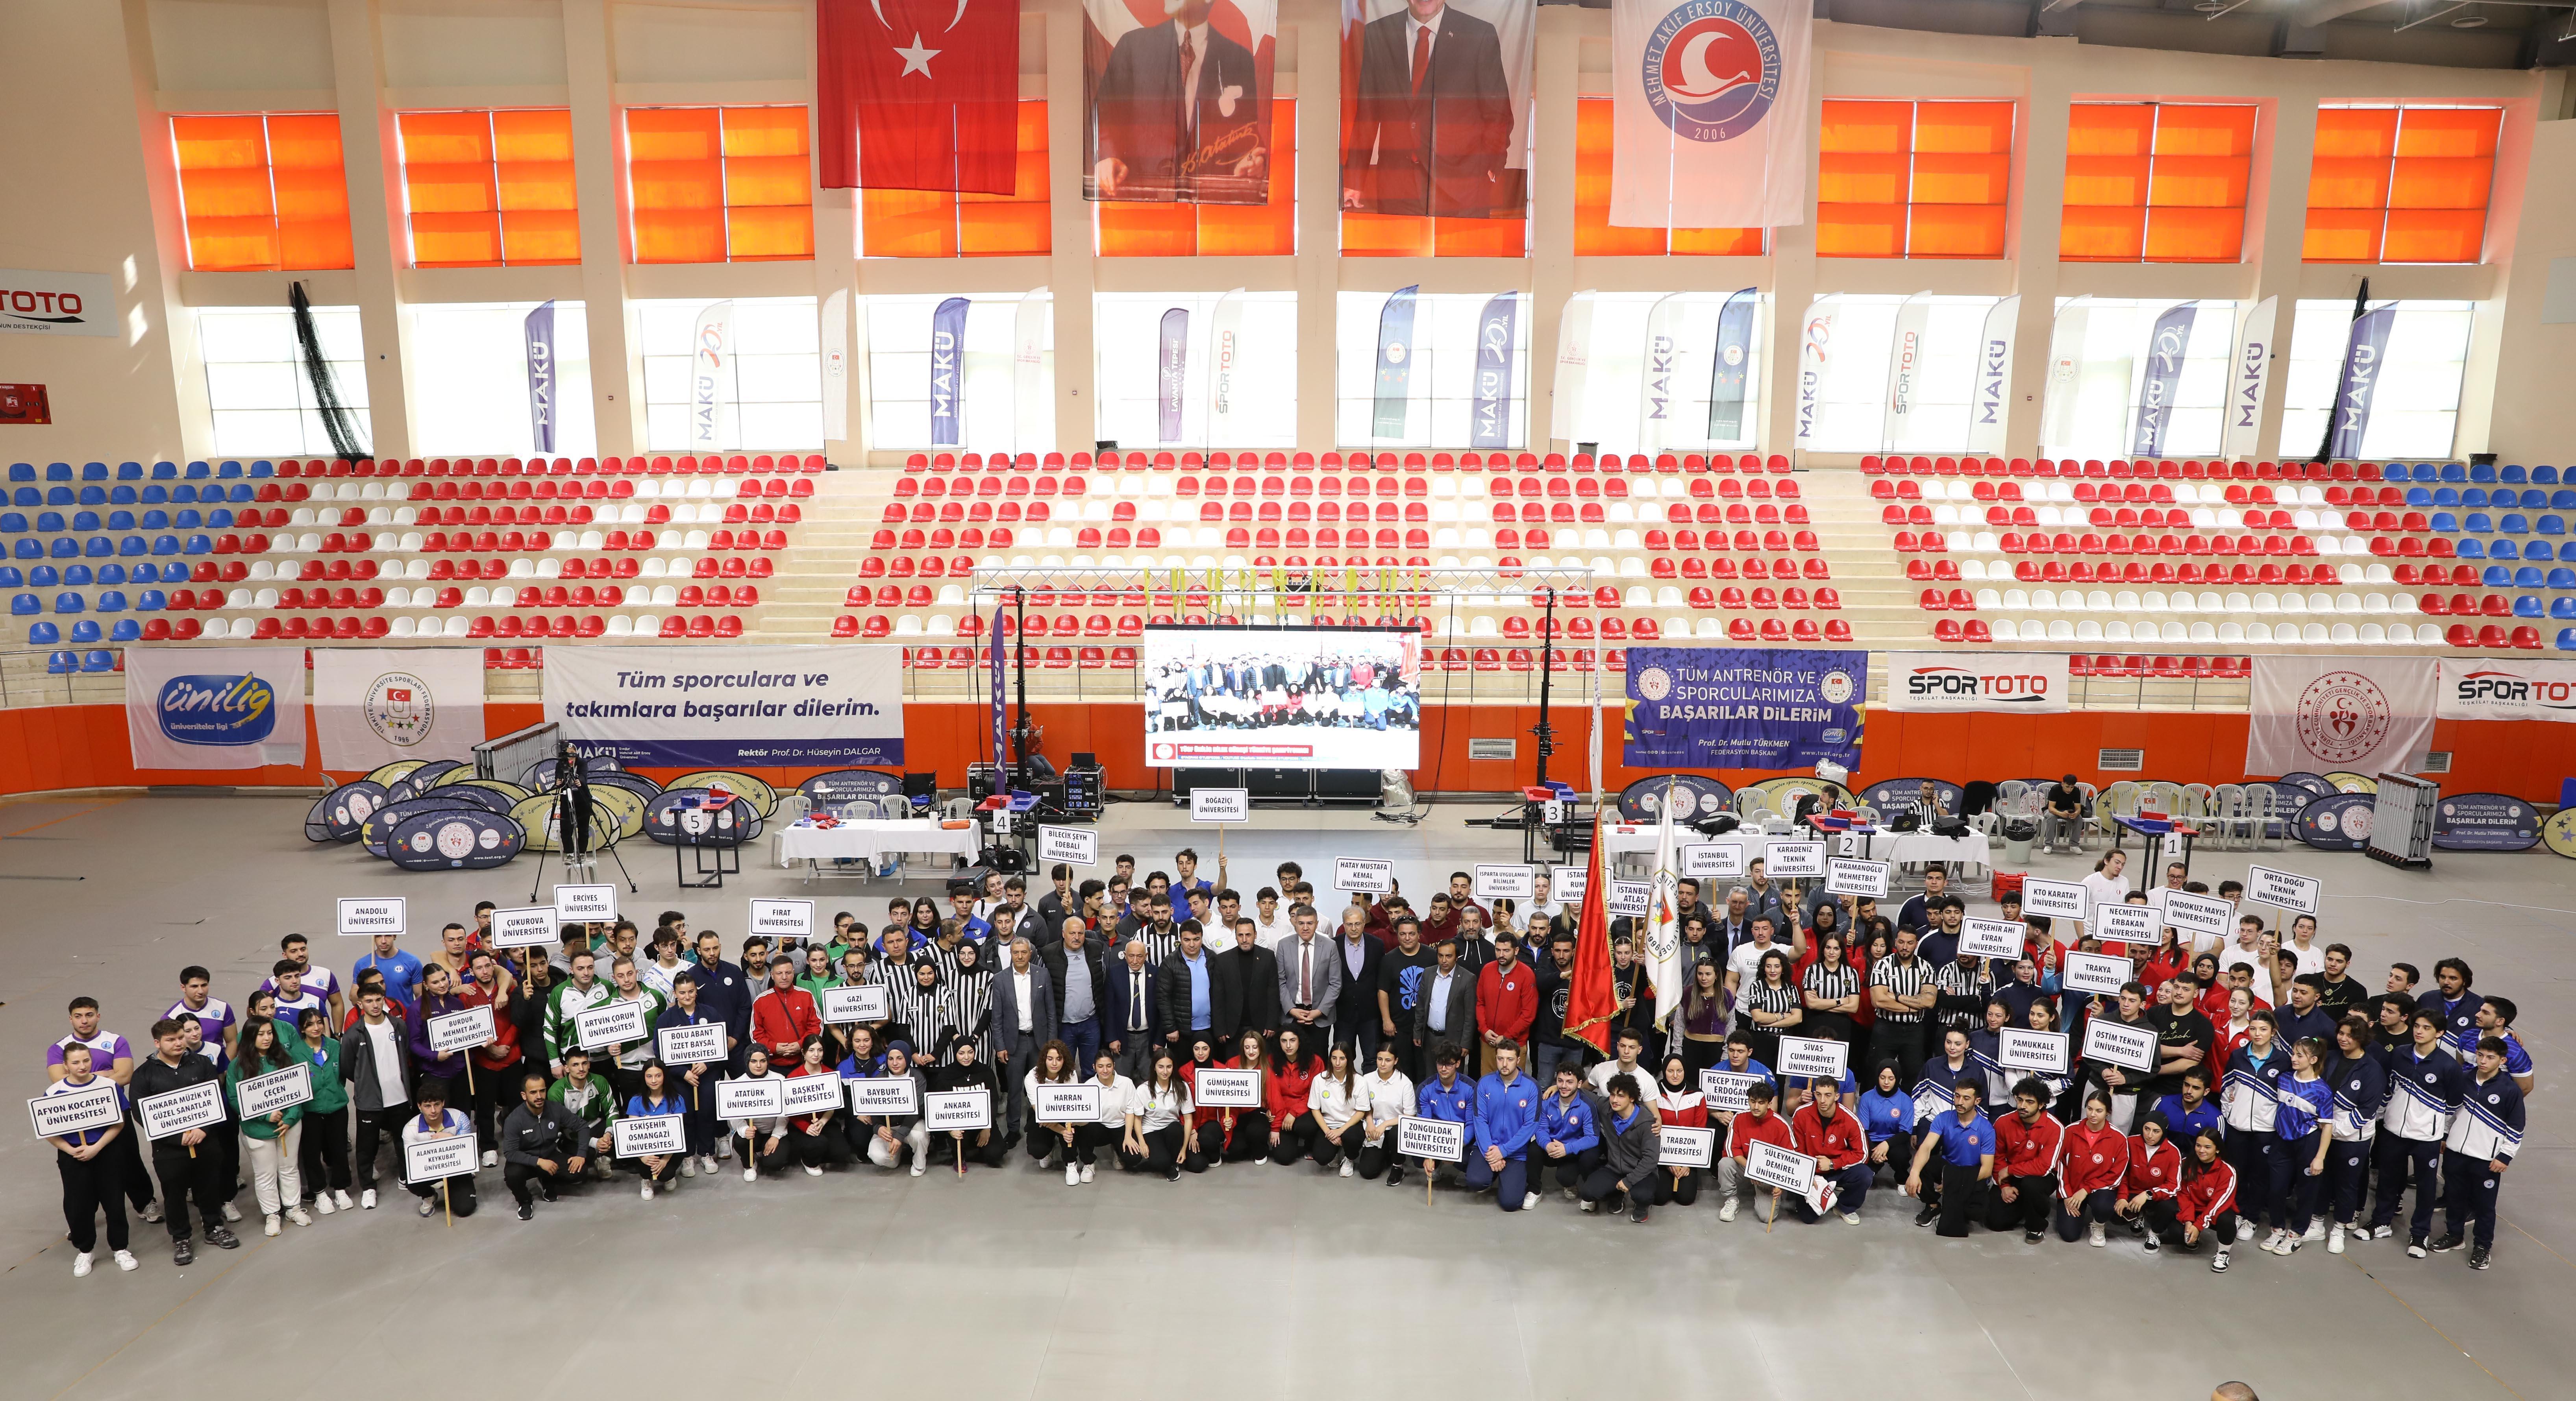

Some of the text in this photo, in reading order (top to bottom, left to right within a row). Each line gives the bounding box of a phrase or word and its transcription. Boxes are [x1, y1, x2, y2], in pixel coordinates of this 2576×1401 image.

[1646, 1, 1781, 106] MEHMET AKİF ERSOY ÜNİVERSİTESİ
[1694, 128, 1726, 140] 2006
[933, 331, 954, 416] MAKÜ
[1649, 336, 1673, 419] MAKÜ
[533, 342, 549, 425] MAKÜ
[1979, 340, 2006, 423] MAKÜ
[2237, 342, 2263, 427] MAKÜ
[2341, 345, 2375, 430] MAKÜ
[617, 670, 829, 692] Tüm sporculara ve
[1676, 666, 1815, 684] TÜM ANTRENÖR VE
[1677, 686, 1816, 702] SPORCULARIMIZA
[566, 698, 879, 722] takımlara başarılar dilerim.
[1660, 705, 1759, 722] BAŞARILAR
[1753, 738, 1790, 747] TÜRKMEN
[807, 748, 841, 757] Hüseyin
[1549, 806, 1558, 820] 3
[691, 815, 700, 829] 5
[997, 816, 1007, 830] 4
[1049, 830, 1071, 839] BİLECİK
[1055, 841, 1079, 849] EDEBALİ
[1844, 838, 1853, 852] 2
[2169, 840, 2176, 854] 1
[1835, 862, 1882, 873] KARAMANOĞLU
[1838, 872, 1877, 882] MEHMETBEY
[2264, 873, 2304, 887] ORTA DOĞU
[1617, 885, 1648, 895] İSTANBU
[2048, 890, 2077, 899] KARATAY
[2270, 884, 2296, 896] TEKNİK
[2032, 898, 2077, 909] ÜNİVERSİTESİ
[2257, 890, 2306, 908] ÜNİVERSİTESİ
[2110, 908, 2149, 918] NECMETTİN
[2169, 900, 2226, 917] ONDOKUZ MAYIS
[507, 917, 544, 928] ÇUKUROVA
[1972, 923, 2002, 932] KIRŞEHİR
[2112, 918, 2144, 928] ERBAKAN
[503, 927, 549, 937] ÜNİVERSİTESİ
[1981, 934, 2002, 943] EVRAN
[2086, 964, 2111, 973] TRAKYA
[2074, 973, 2121, 985] ÜNİVERSİTESİ
[833, 1004, 877, 1013] ÜNİVERSİTESİ
[449, 1016, 473, 1027] BURDUR
[585, 1012, 635, 1028] ARTVİN ÇORUH
[443, 1023, 481, 1037] MEHMET AKİF
[671, 1029, 713, 1040] BOLU ABANT
[435, 1029, 492, 1049] ERSOY ÜNİVERSİTESİ
[690, 1039, 715, 1048] BAYSAL
[2013, 1039, 2054, 1050] PAMUKKALE
[2096, 1031, 2145, 1048] OSTİM TEKNİK
[1804, 1042, 1823, 1052] SİVAS
[2095, 1041, 2142, 1058] ÜNİVERSİTESİ
[1790, 1053, 1835, 1063] CUMHURİYET
[2010, 1050, 2056, 1061] ÜNİVERSİTESİ
[1788, 1063, 1835, 1074] ÜNİVERSİTESİ
[248, 1070, 298, 1092] AĞRI İBRAHİM
[1207, 1079, 1248, 1087] GÜMÜŞHANE
[1708, 1076, 1729, 1085] RECEP
[264, 1085, 286, 1098] ÇEÇEN
[735, 1089, 764, 1098] ATATÜRK
[792, 1083, 824, 1095] BAŞKENT
[37, 1096, 111, 1116] AFYON KOCATEPE
[149, 1098, 178, 1111] ANKARA
[179, 1092, 202, 1103] MÜZİK
[727, 1099, 773, 1109] ÜNİVERSİTESİ
[46, 1106, 107, 1125] ÜNİVERSİTESİ
[153, 1100, 212, 1120] GÜZEL SANATLAR
[630, 1121, 666, 1131] ESKİŞEHİR
[1409, 1123, 1452, 1135] ZONGULDAK
[629, 1131, 670, 1141] OSMANGAZİ
[1404, 1131, 1457, 1145] BÜLENT ECEVİT
[1667, 1137, 1696, 1145] TRABZON
[417, 1144, 466, 1157] ALANYA ALAADDİN
[428, 1153, 455, 1162] KEYKUBAT
[1765, 1149, 1800, 1165] SÜLEYMAN
[424, 1160, 461, 1171] ÜNİVERSİTESİ
[1766, 1159, 1795, 1175] DEMİREL
